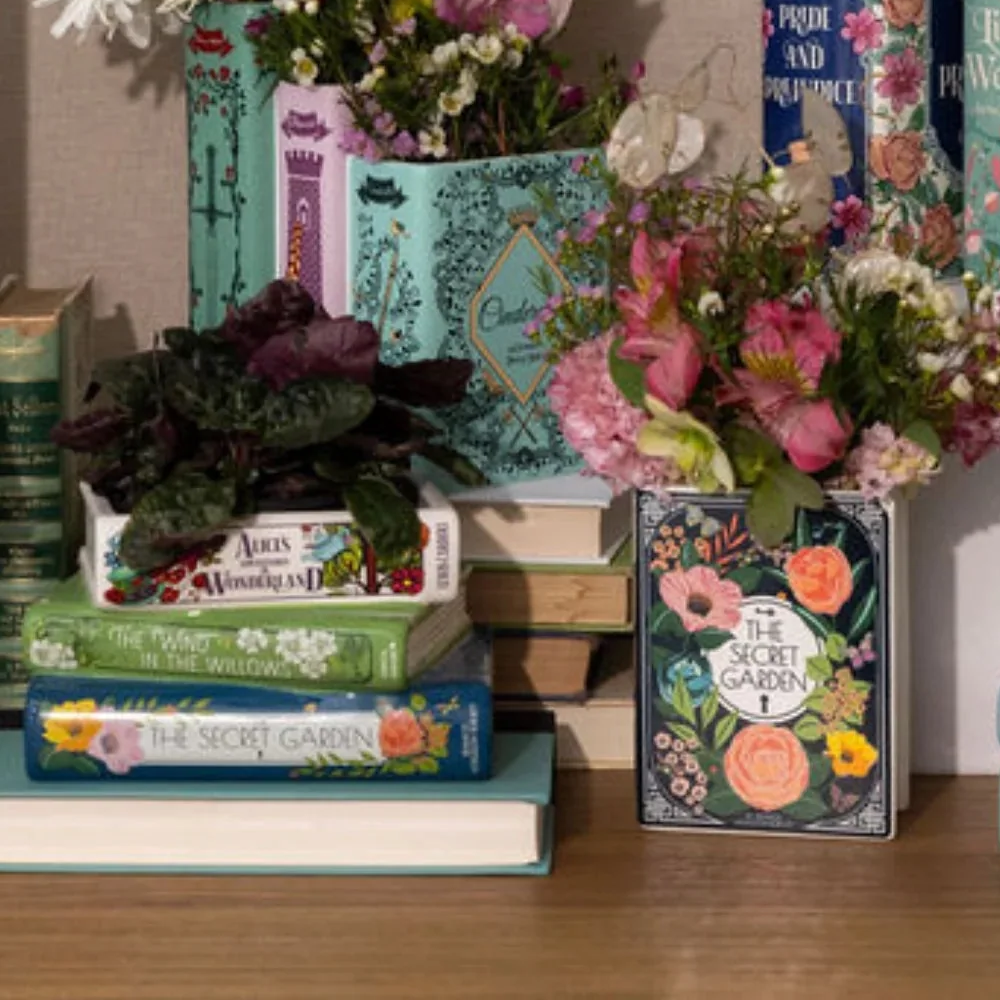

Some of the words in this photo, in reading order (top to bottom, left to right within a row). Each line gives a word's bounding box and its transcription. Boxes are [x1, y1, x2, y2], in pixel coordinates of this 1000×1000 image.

[779, 4, 831, 36] PRIDE
[785, 36, 825, 70] AND
[746, 619, 784, 643] THE
[168, 652, 199, 672] THE
[729, 643, 800, 667] SECRET
[720, 666, 807, 693] GARDEN
[151, 726, 187, 749] THE
[199, 725, 271, 750] SECRET
[278, 726, 374, 750] GARDEN
